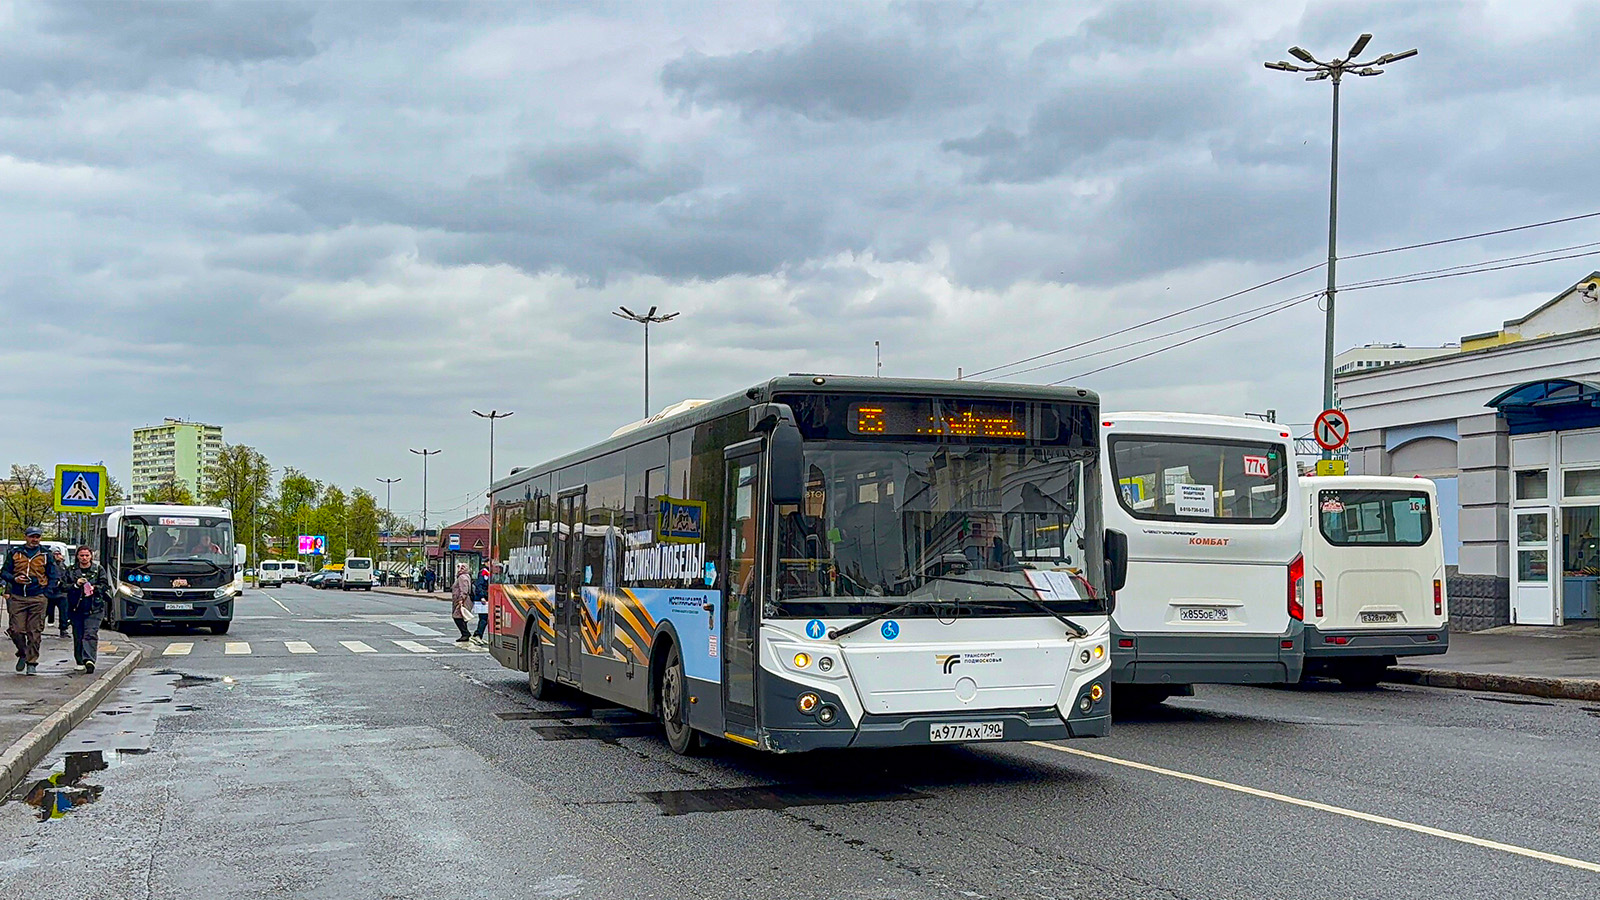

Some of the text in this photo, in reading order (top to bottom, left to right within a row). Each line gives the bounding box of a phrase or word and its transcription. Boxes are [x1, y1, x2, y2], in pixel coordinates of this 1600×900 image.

[1188, 537, 1230, 546] КОМБАТ
[623, 542, 662, 582] ВЕЛИКОЙ
[661, 542, 706, 586] ПОБЕДЫ!
[934, 726, 980, 739] А977АХ
[983, 723, 1000, 734] 790
